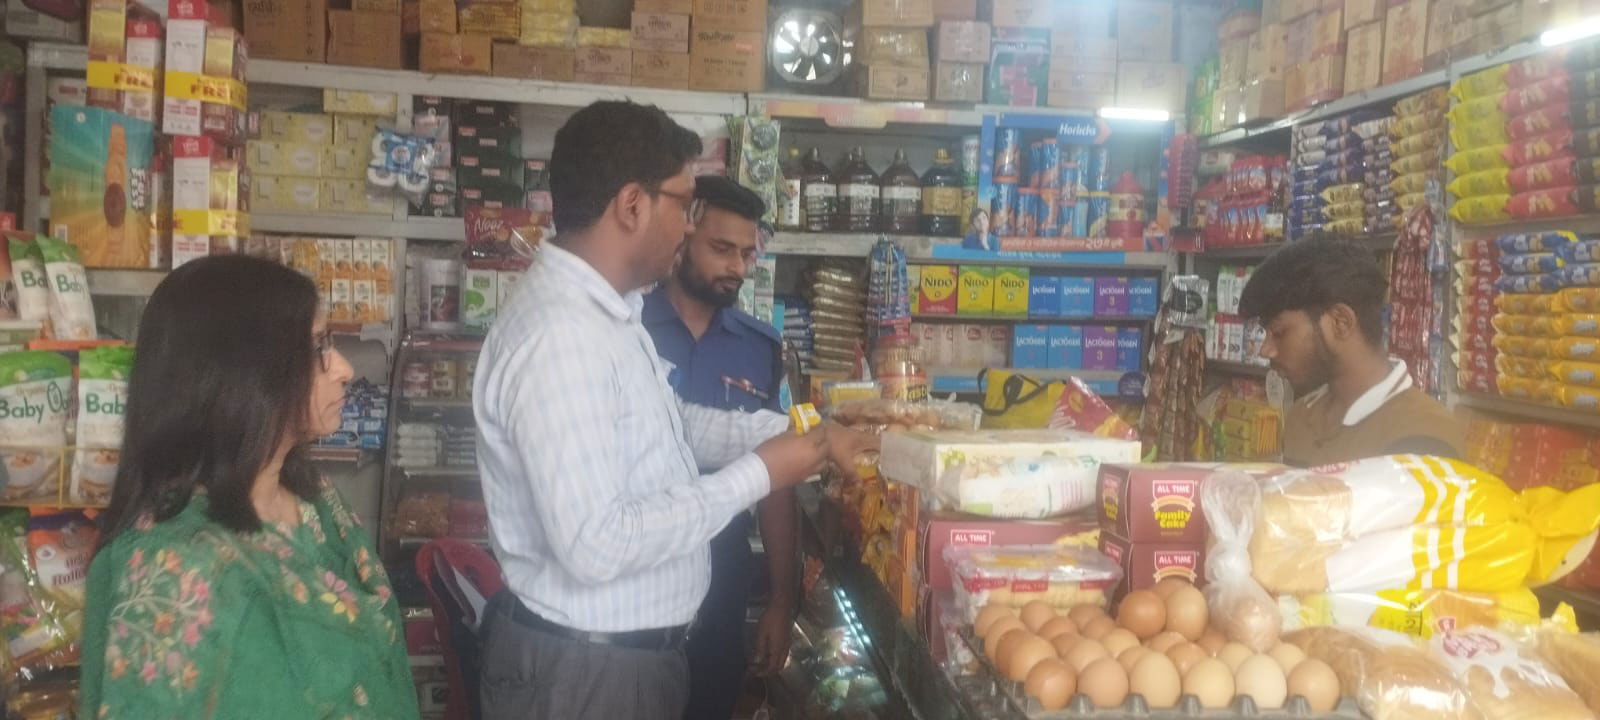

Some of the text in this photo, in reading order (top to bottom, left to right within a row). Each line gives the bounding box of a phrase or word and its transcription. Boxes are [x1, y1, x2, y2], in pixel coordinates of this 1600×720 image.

[1157, 484, 1190, 493] ALL TIME
[1154, 511, 1191, 522] Family
[1160, 519, 1186, 529] Cake
[954, 534, 987, 544] ALL TIME
[1159, 555, 1191, 565] ALL TIME
